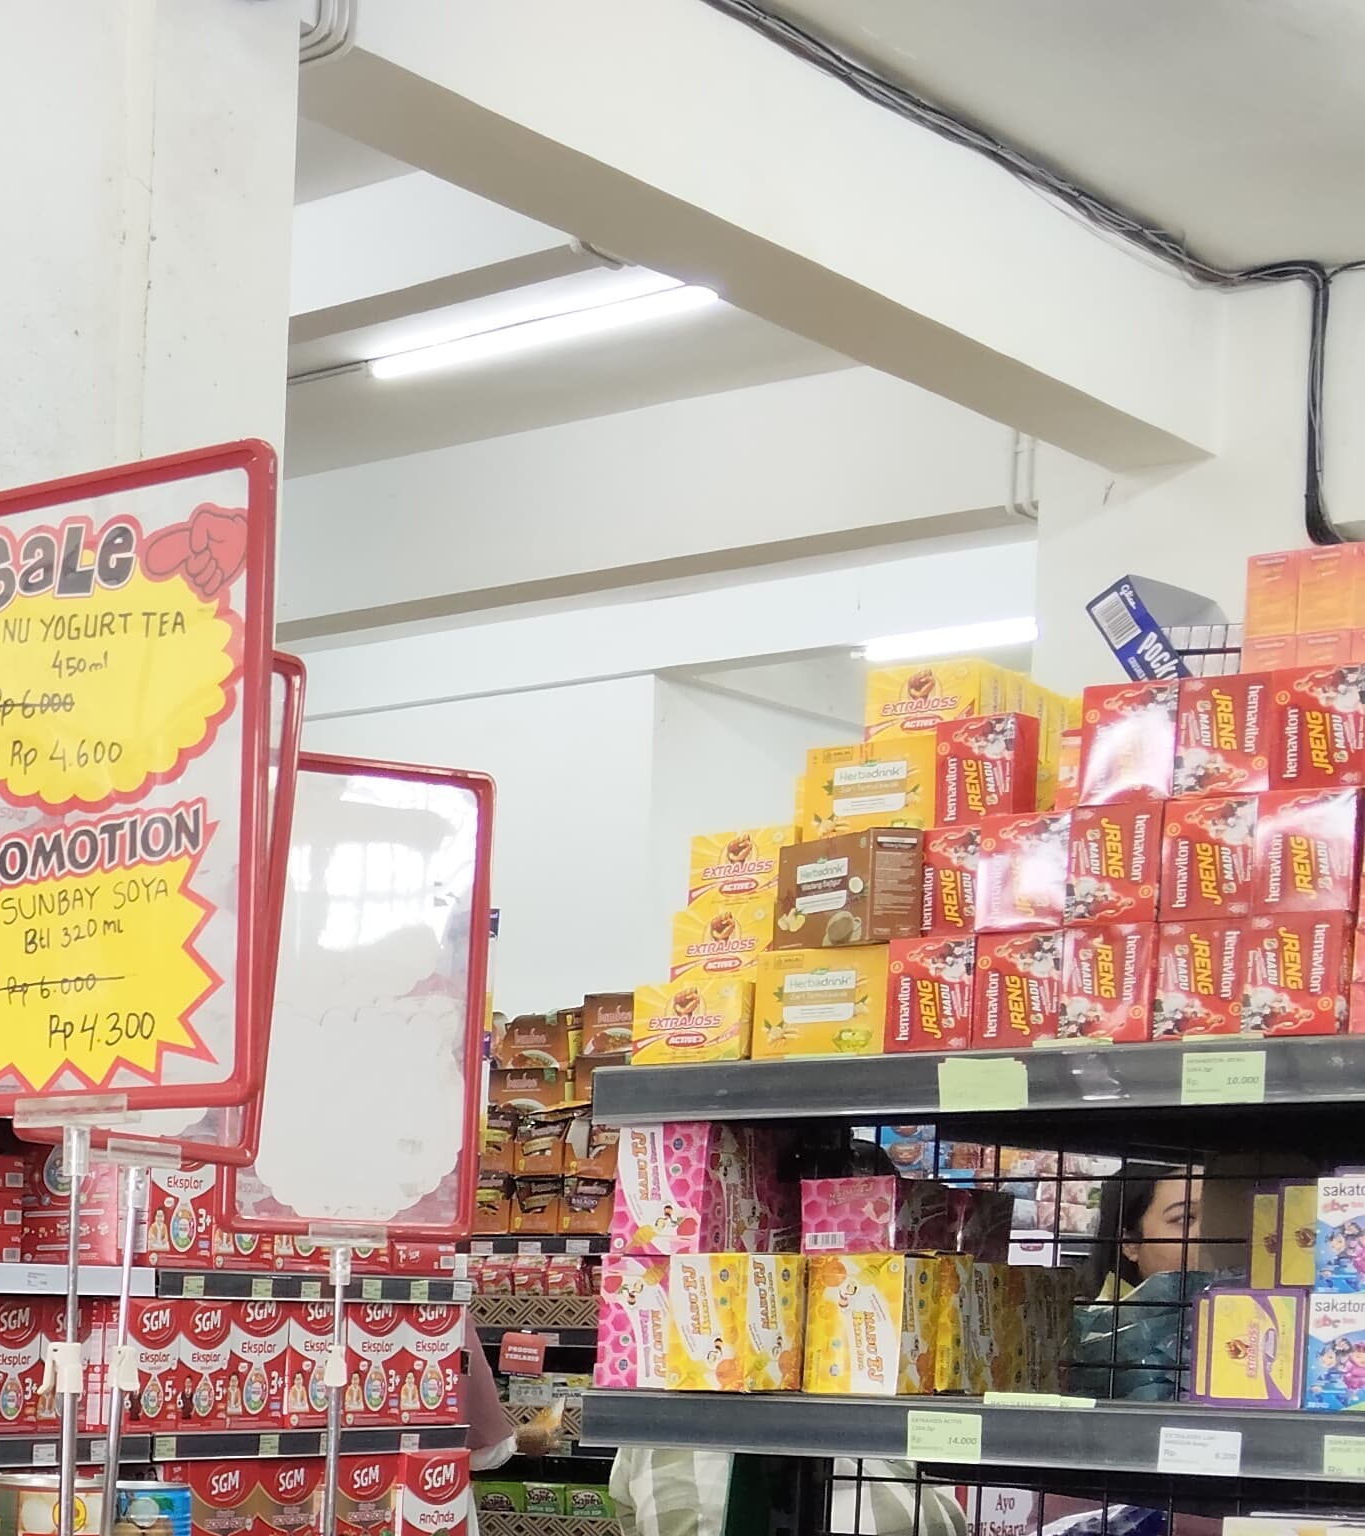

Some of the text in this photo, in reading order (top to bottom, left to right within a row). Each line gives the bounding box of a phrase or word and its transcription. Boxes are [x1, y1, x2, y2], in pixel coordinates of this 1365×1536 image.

[2, 611, 187, 643] NU YOGURT TEA
[10, 740, 123, 775] Rp 4.600
[702, 860, 773, 879] EXTRAJOSS
[1198, 842, 1223, 905] JRENG
[1, 879, 169, 925] SUNBAY SOYA
[24, 929, 50, 953] Btl
[895, 976, 911, 1041] hemaviton
[922, 980, 942, 1039] JRENG
[942, 984, 950, 1016] MADU
[49, 1011, 155, 1052] Rp 4.300
[647, 1014, 723, 1030] EXTRAJOSS
[667, 1033, 703, 1046] ACTIVE
[1226, 1076, 1260, 1085] 10.000
[995, 1496, 1015, 1512] Ayo
